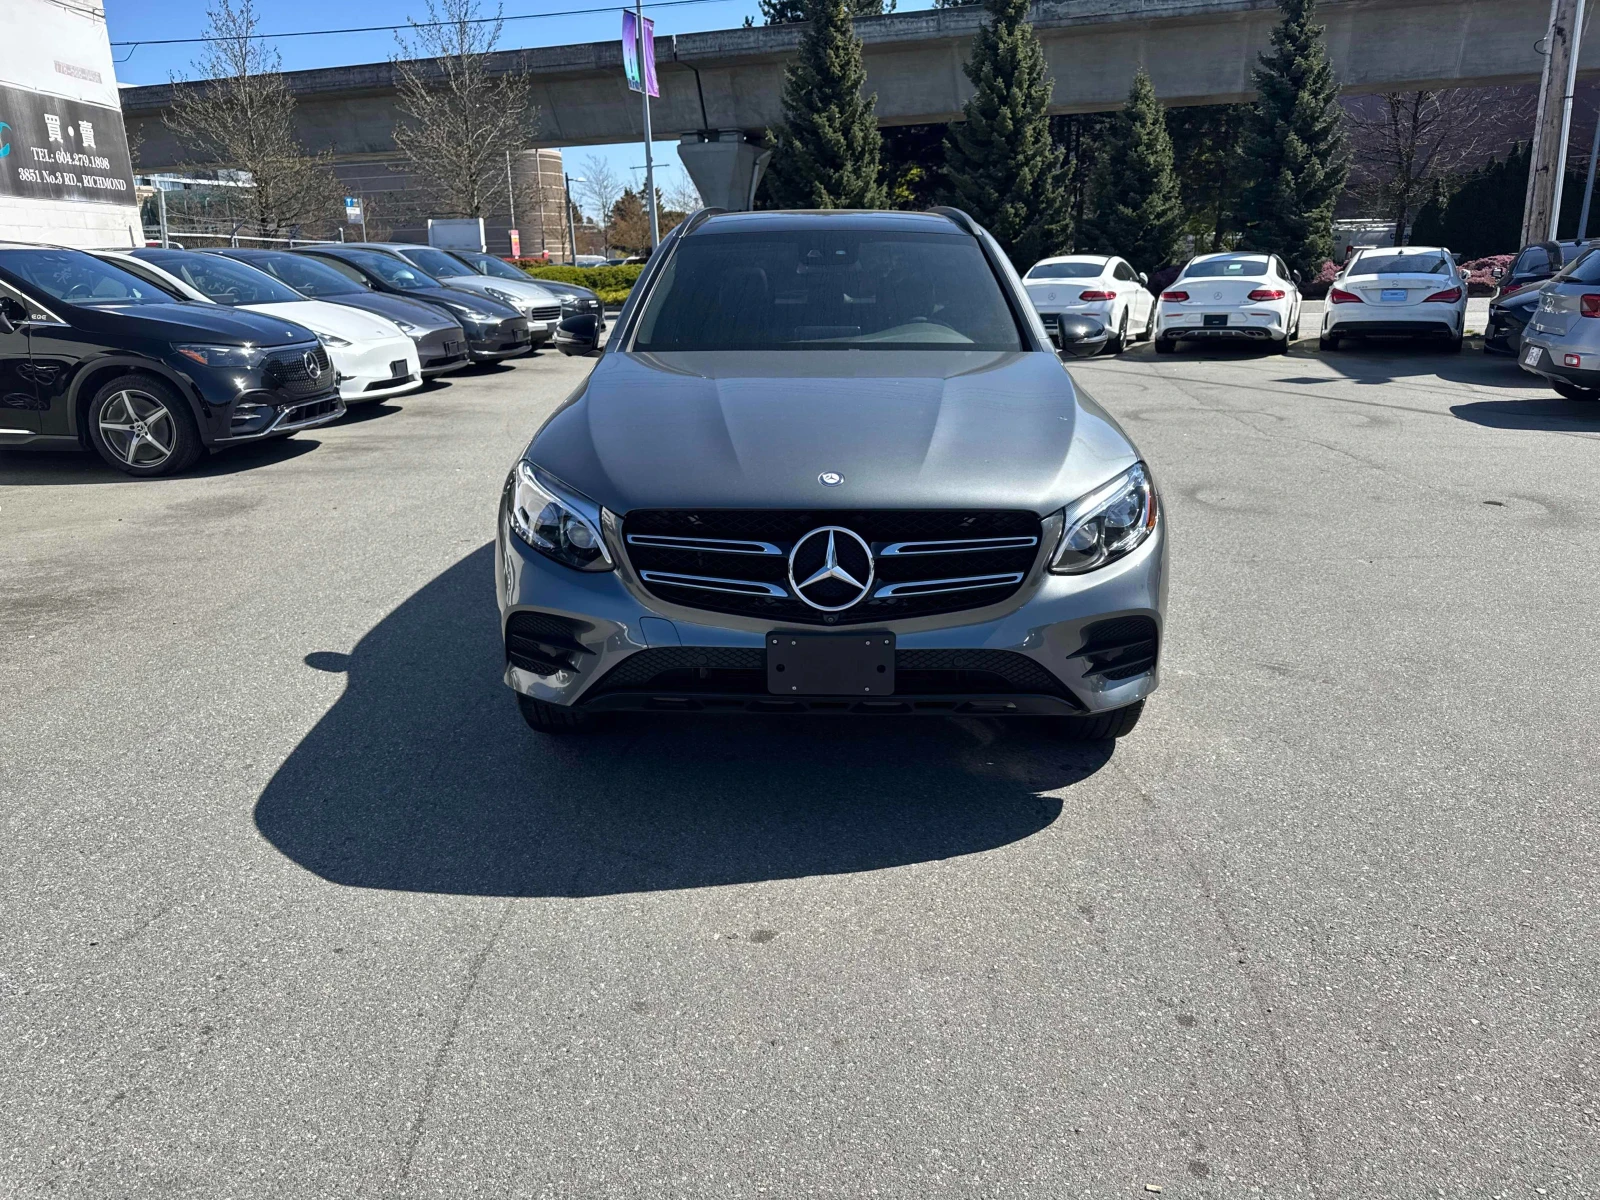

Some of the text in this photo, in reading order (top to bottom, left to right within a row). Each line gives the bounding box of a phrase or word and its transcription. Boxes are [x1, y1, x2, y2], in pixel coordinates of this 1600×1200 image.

[31, 147, 110, 170] TEL: 604.279.1898
[18, 168, 40, 183] 3851
[42, 170, 62, 185] No.3
[82, 174, 127, 191] RICHMOND
